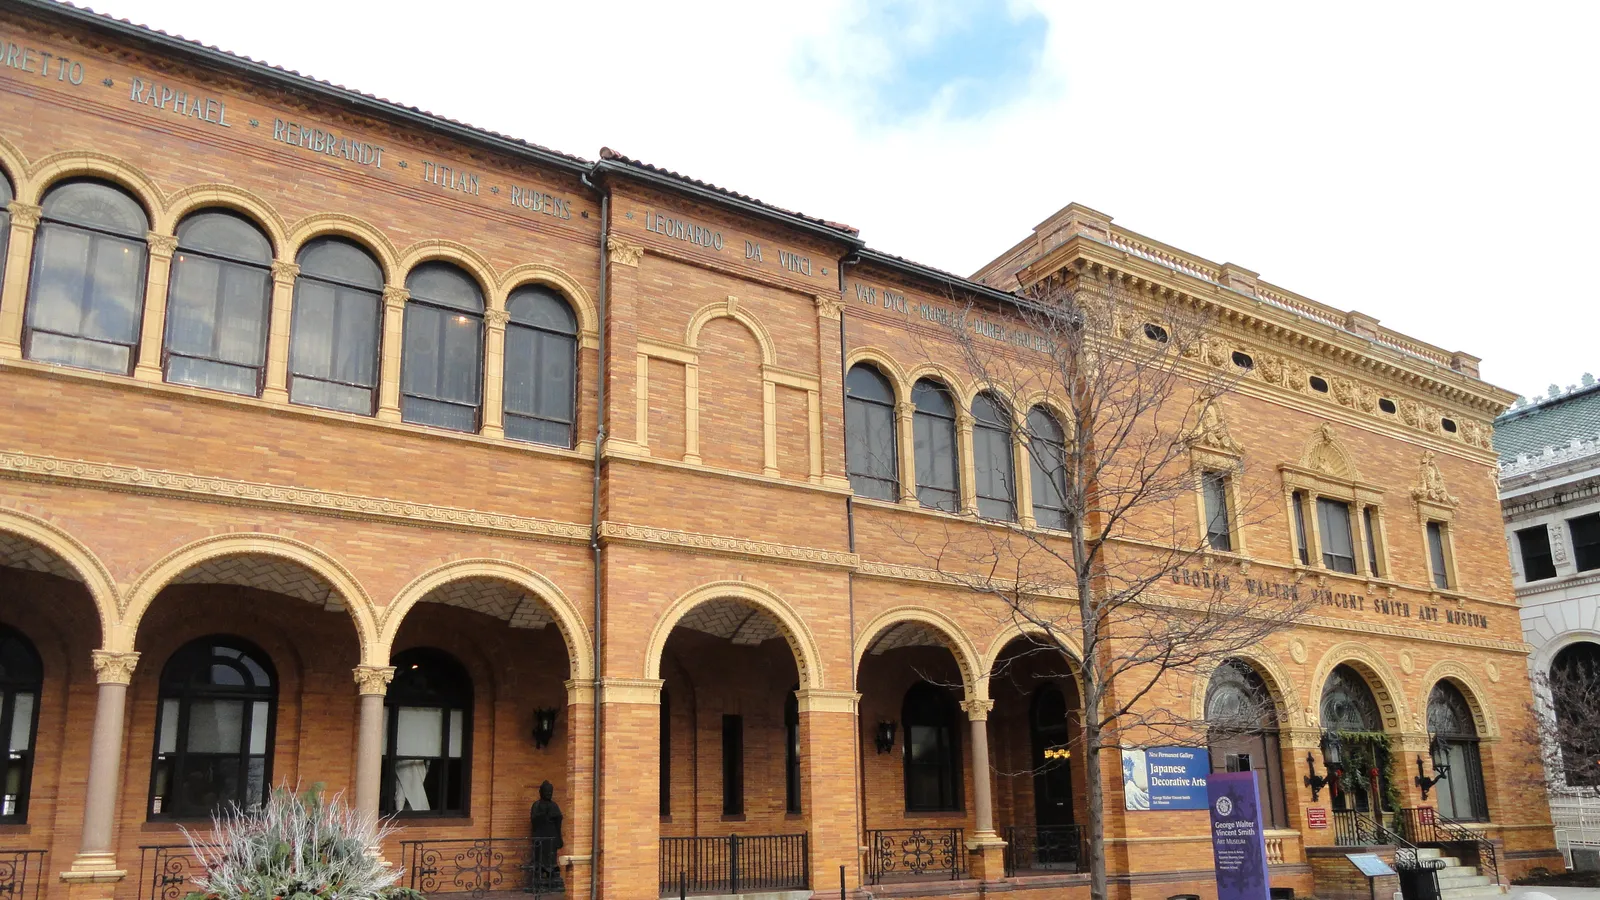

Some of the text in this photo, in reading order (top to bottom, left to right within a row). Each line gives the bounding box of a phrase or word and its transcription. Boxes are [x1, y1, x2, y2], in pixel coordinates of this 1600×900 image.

[130, 76, 232, 127] RAPHAEL
[273, 117, 385, 169] REMBRANDT
[422, 159, 480, 196] TITIAN
[511, 184, 572, 221] RUBENS
[646, 211, 813, 277] LEONARDO DA VINCI
[855, 283, 877, 306] VAN
[883, 291, 910, 315] DYCK
[1171, 566, 1488, 629] GEORGE WALTER VINCENT SMITH ART MUSEUM
[1150, 763, 1186, 776] Japanese
[1151, 776, 1207, 787] Decorative Arts
[1215, 820, 1254, 829] George Walter
[1238, 828, 1255, 836] Smith
